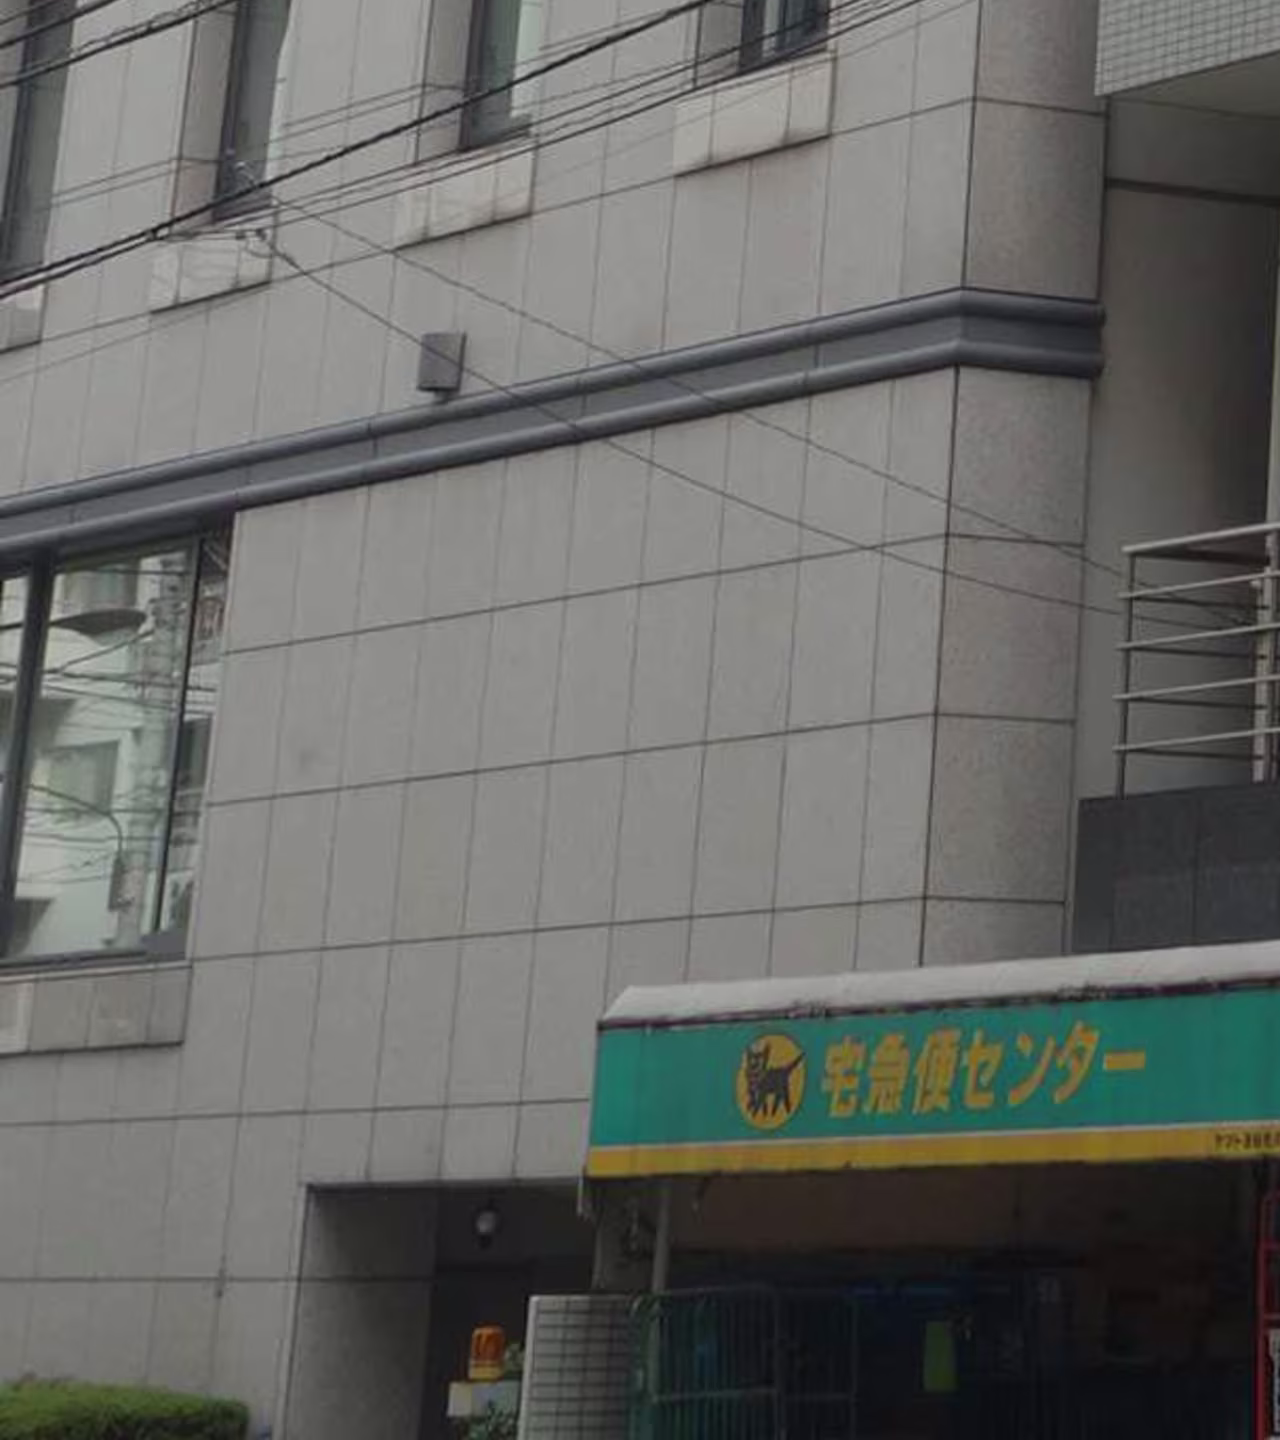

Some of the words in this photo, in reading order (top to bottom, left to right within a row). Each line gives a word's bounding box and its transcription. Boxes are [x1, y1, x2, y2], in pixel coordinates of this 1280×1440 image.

[822, 1021, 1146, 1118] 宅急便センター
